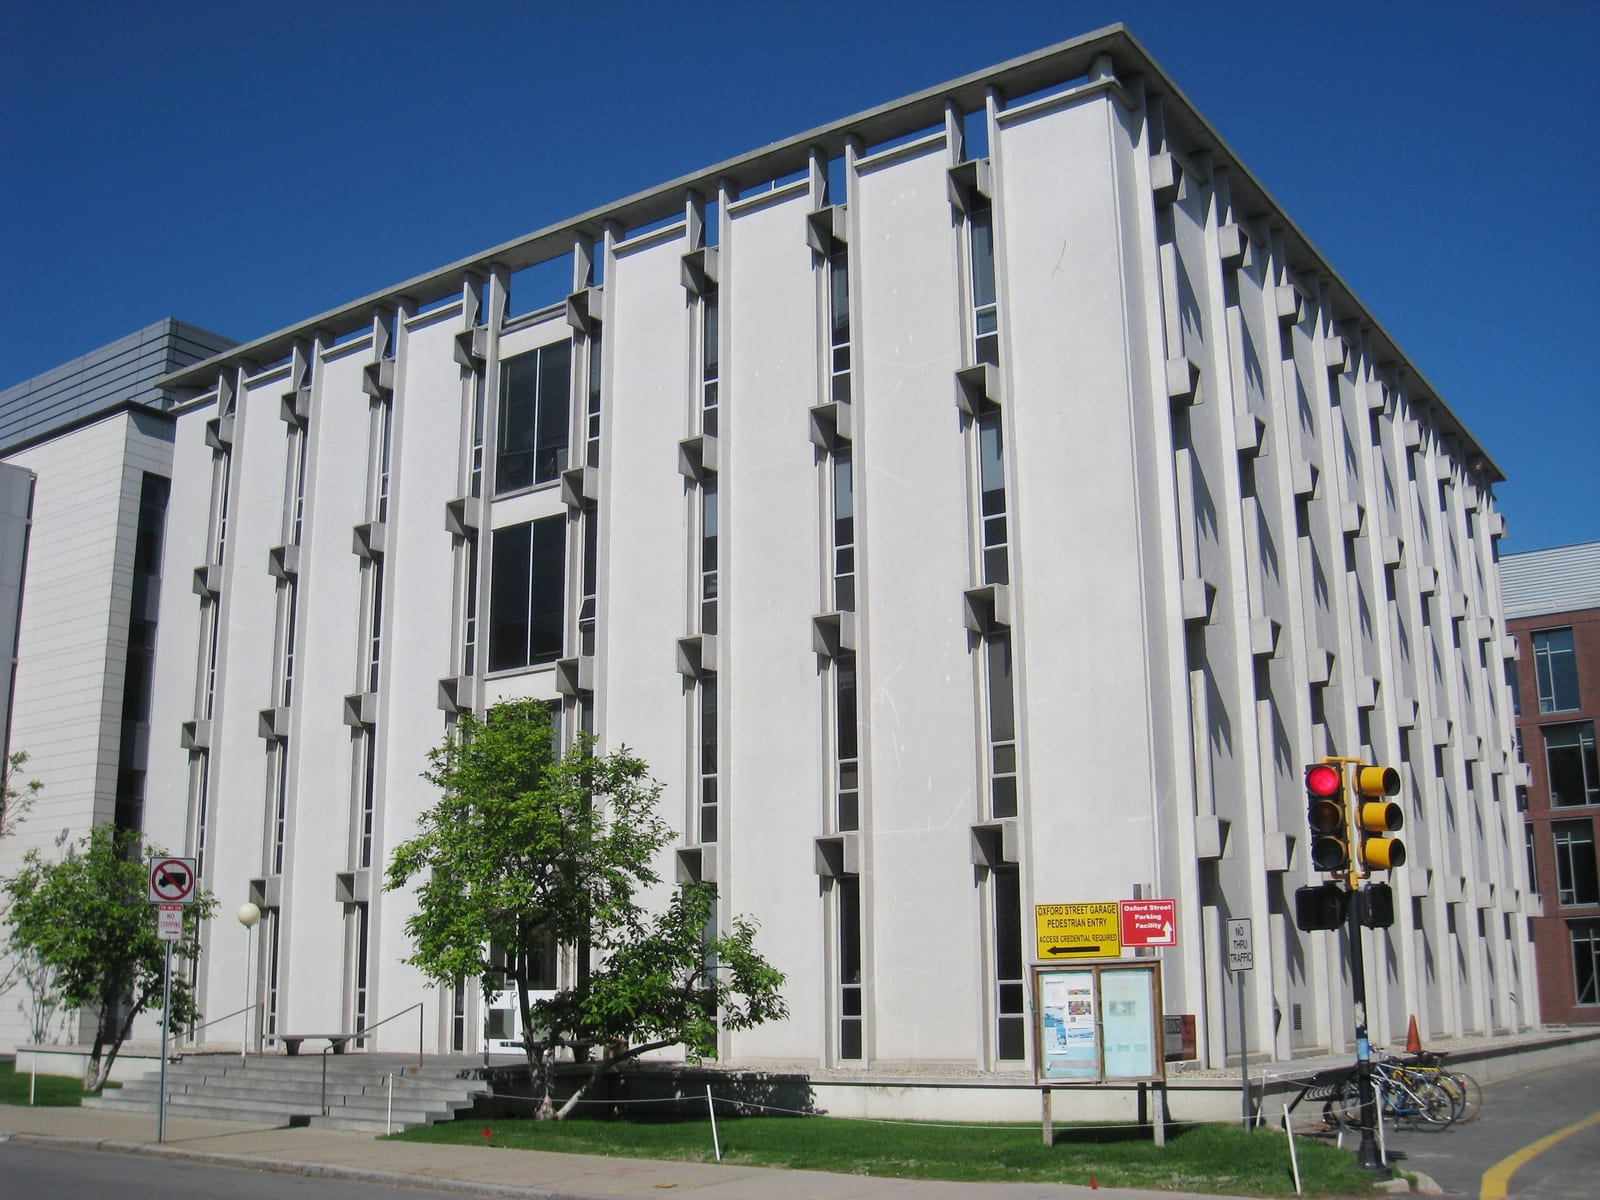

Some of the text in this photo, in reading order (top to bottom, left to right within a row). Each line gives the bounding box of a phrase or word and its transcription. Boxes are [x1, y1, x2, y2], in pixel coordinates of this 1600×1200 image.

[1038, 905, 1116, 916] OXFORD STREET GARAGE
[1048, 918, 1106, 928] PEDESTRIAN ENTRY
[1235, 926, 1244, 936] NO
[1233, 940, 1248, 949] THRU
[1230, 952, 1252, 962] TRAFFIC
